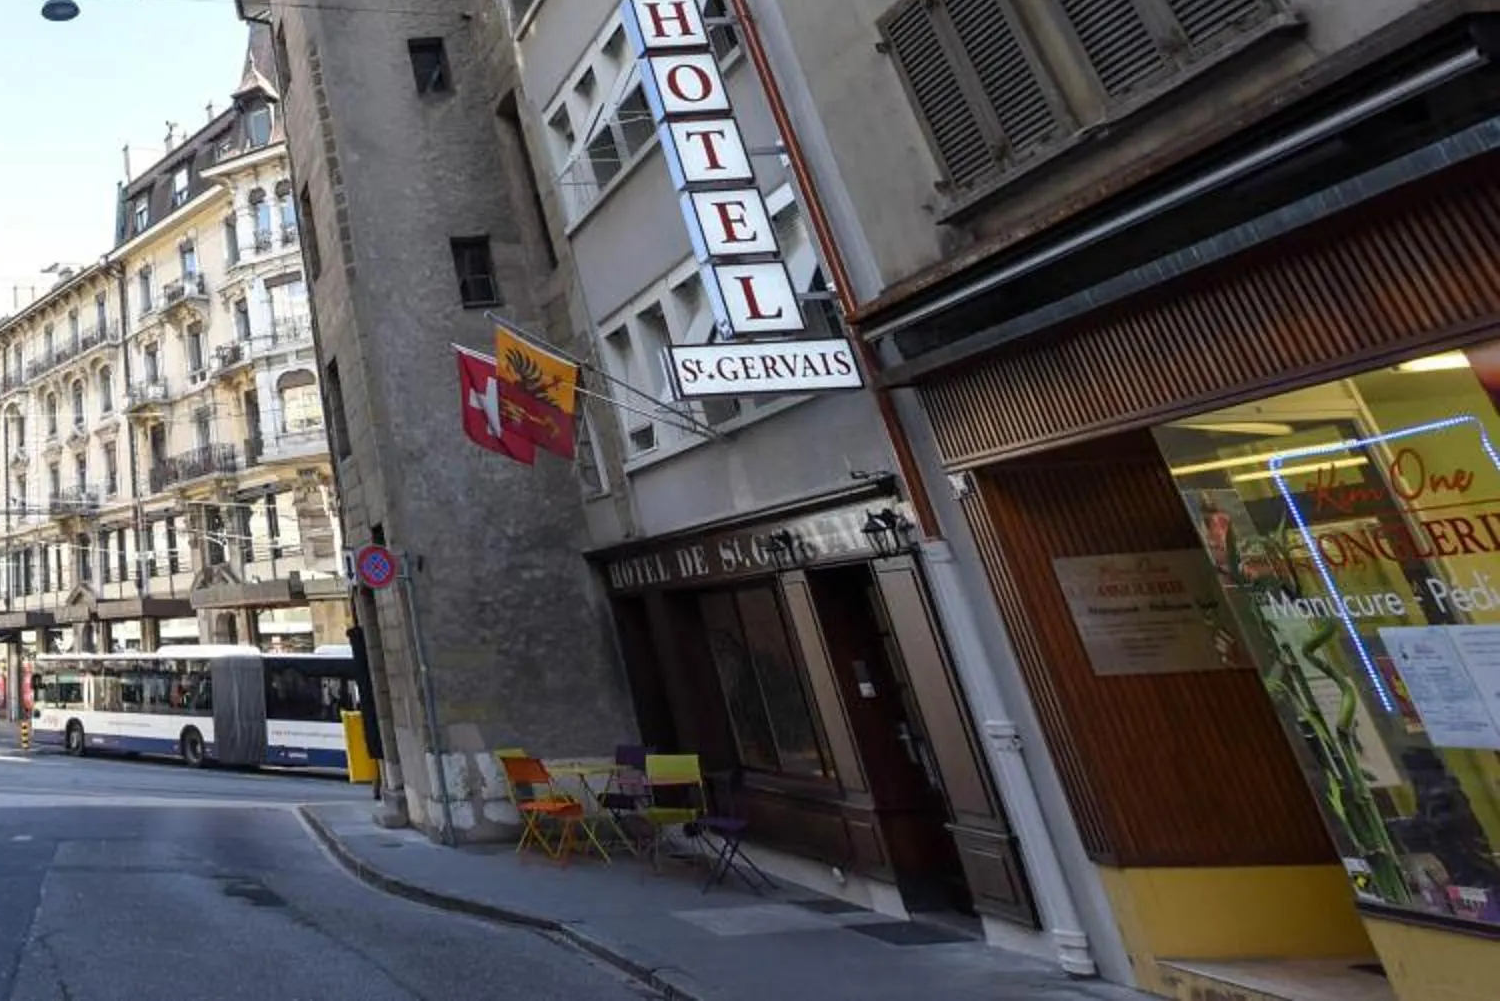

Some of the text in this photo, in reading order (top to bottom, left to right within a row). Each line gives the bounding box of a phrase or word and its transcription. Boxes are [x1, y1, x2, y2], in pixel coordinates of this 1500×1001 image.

[643, 0, 784, 322] HOTEL
[1390, 447, 1475, 500] One
[675, 544, 710, 578] DE
[1316, 511, 1500, 569] ONGLERI
[1266, 586, 1406, 619] Manucure
